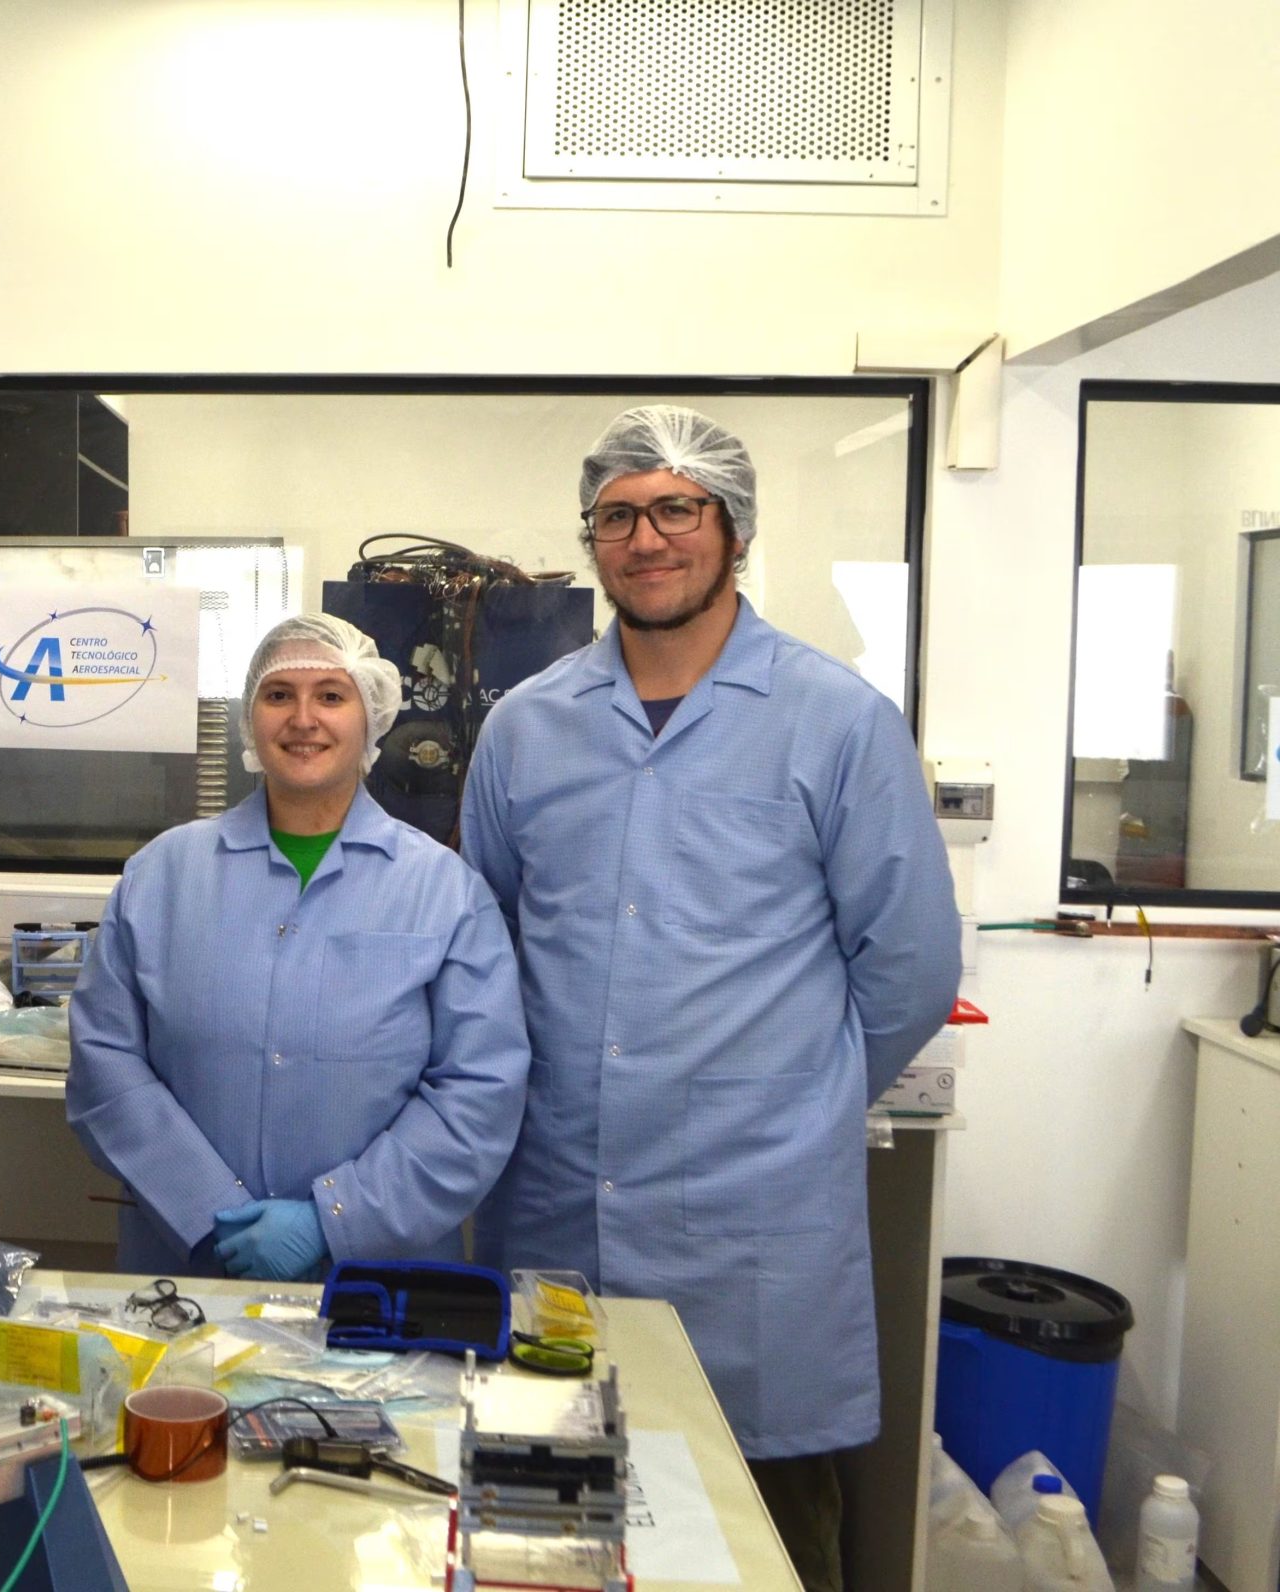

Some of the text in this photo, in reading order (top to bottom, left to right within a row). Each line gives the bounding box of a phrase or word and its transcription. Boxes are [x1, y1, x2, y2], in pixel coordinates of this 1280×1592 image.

[70, 637, 108, 647] CENTRO
[71, 650, 138, 661] TECNOLÓGICO
[72, 664, 141, 675] AEROESPACIAL
